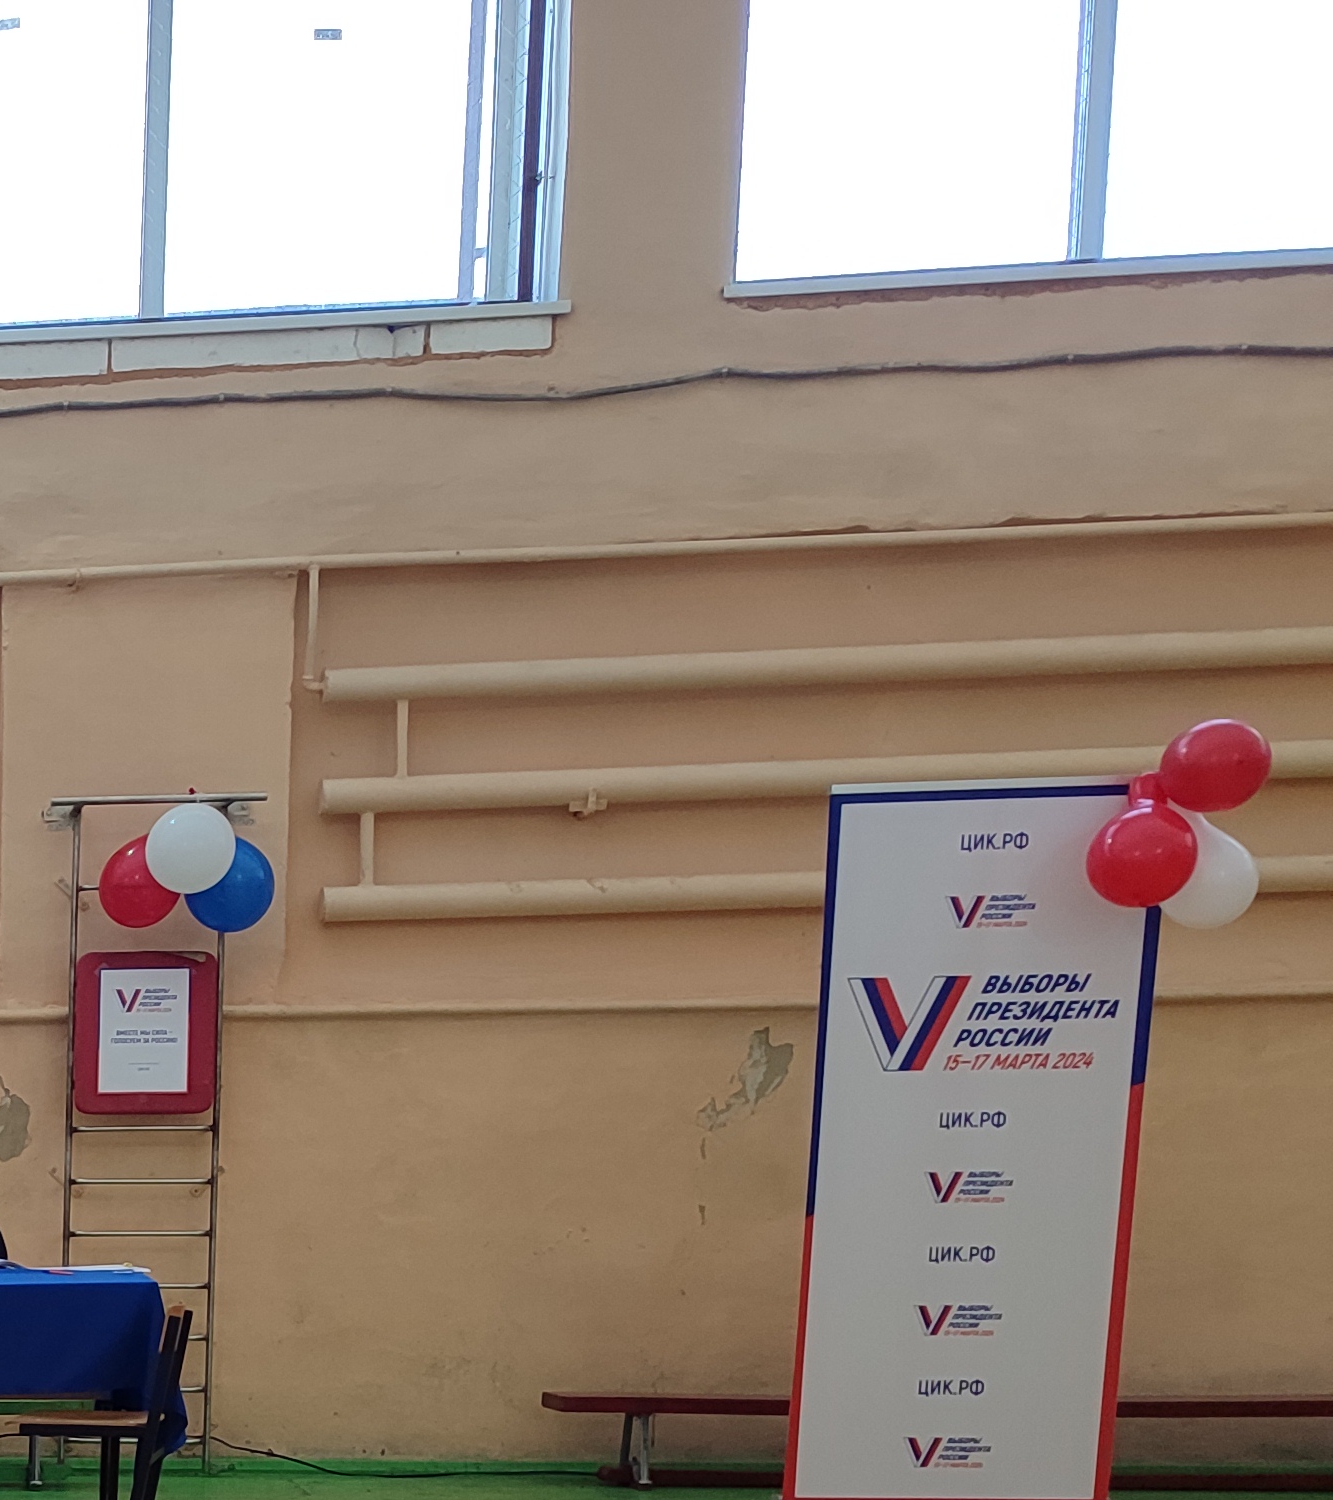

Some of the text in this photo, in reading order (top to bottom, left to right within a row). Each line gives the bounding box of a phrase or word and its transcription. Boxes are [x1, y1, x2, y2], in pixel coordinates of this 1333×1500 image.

[960, 831, 1030, 852] ЦИК.РФ
[981, 973, 1092, 995] ВЫБОРЫ
[967, 999, 1120, 1022] ПРЕЗИДЕНТА
[953, 1028, 1053, 1048] РОССИИ
[990, 1053, 1051, 1070] МАРТА
[1052, 1052, 1095, 1069] 2024
[939, 1111, 1007, 1130] ЦИК.РФ
[929, 1246, 996, 1264] ЦИК.РФ
[918, 1380, 985, 1397] ЦИК.РФ
